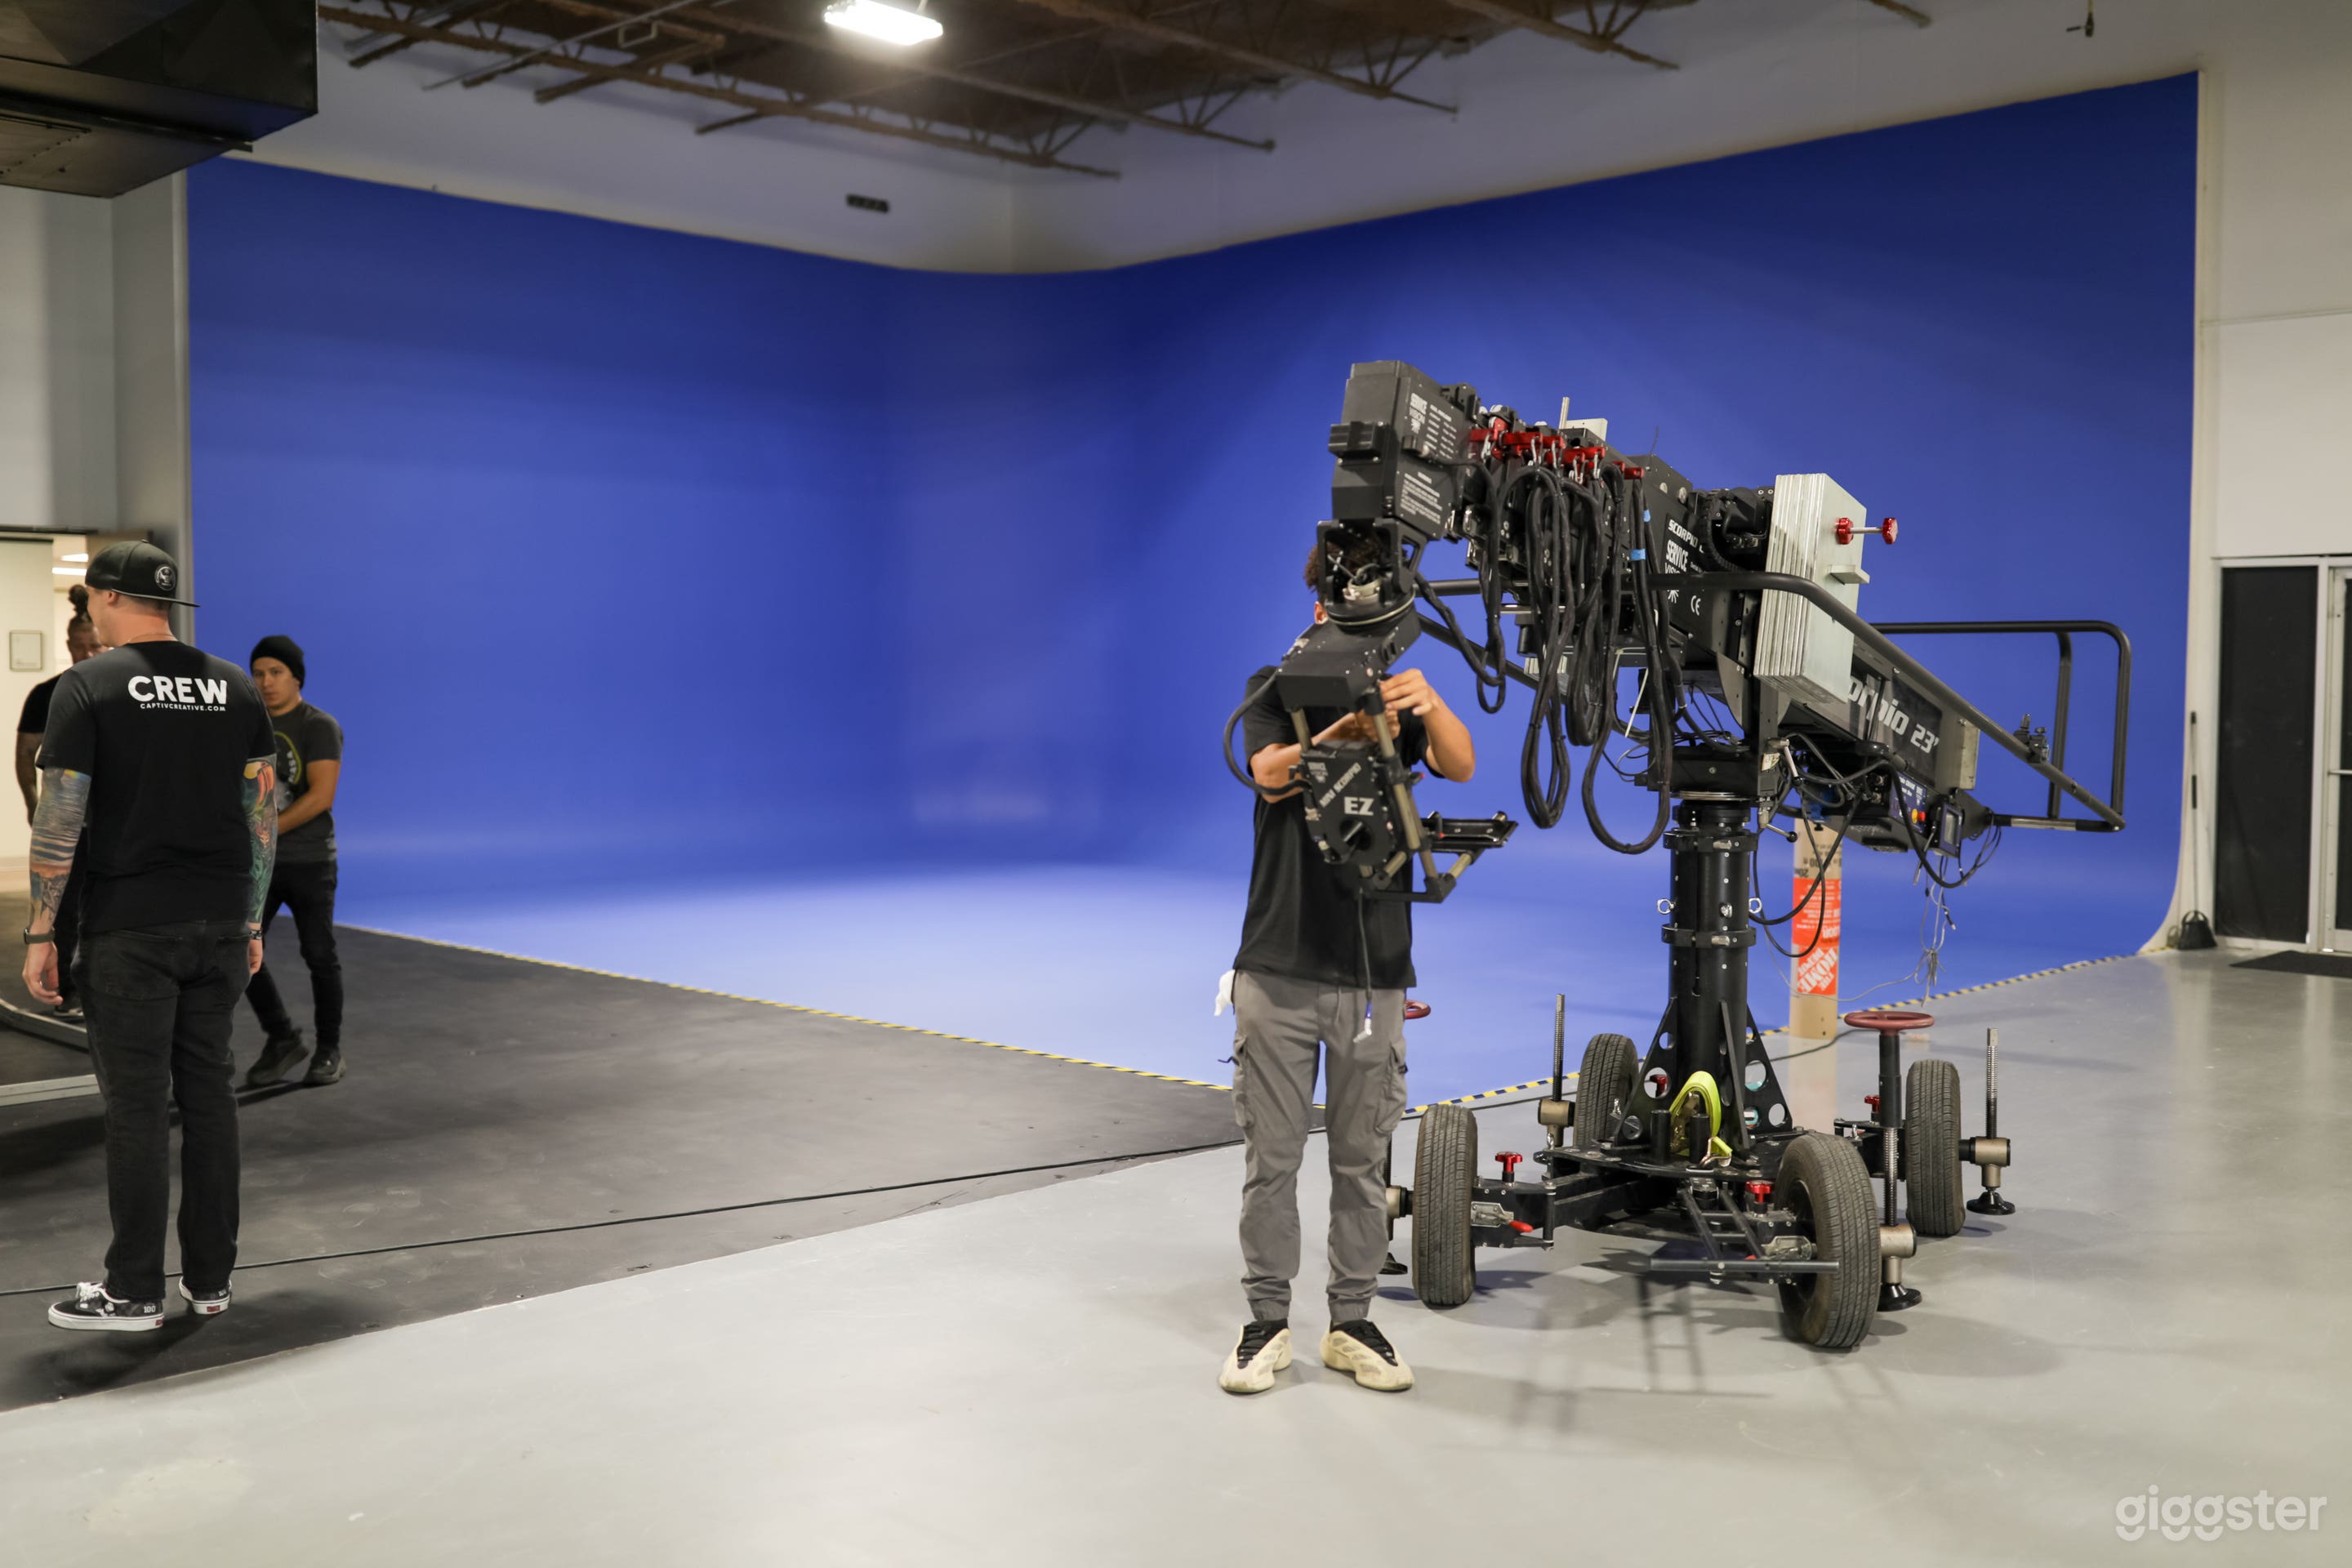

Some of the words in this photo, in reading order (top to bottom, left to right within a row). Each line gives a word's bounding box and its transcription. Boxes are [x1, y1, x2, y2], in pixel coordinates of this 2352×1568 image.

[1668, 519, 1699, 548] SCORPIO
[1666, 540, 1689, 572] SERVICE
[128, 675, 227, 705] CREW
[140, 702, 226, 712] CAPTIVCREATIVE.COM
[1344, 796, 1374, 816] EZ
[1797, 948, 1838, 993] HOME
